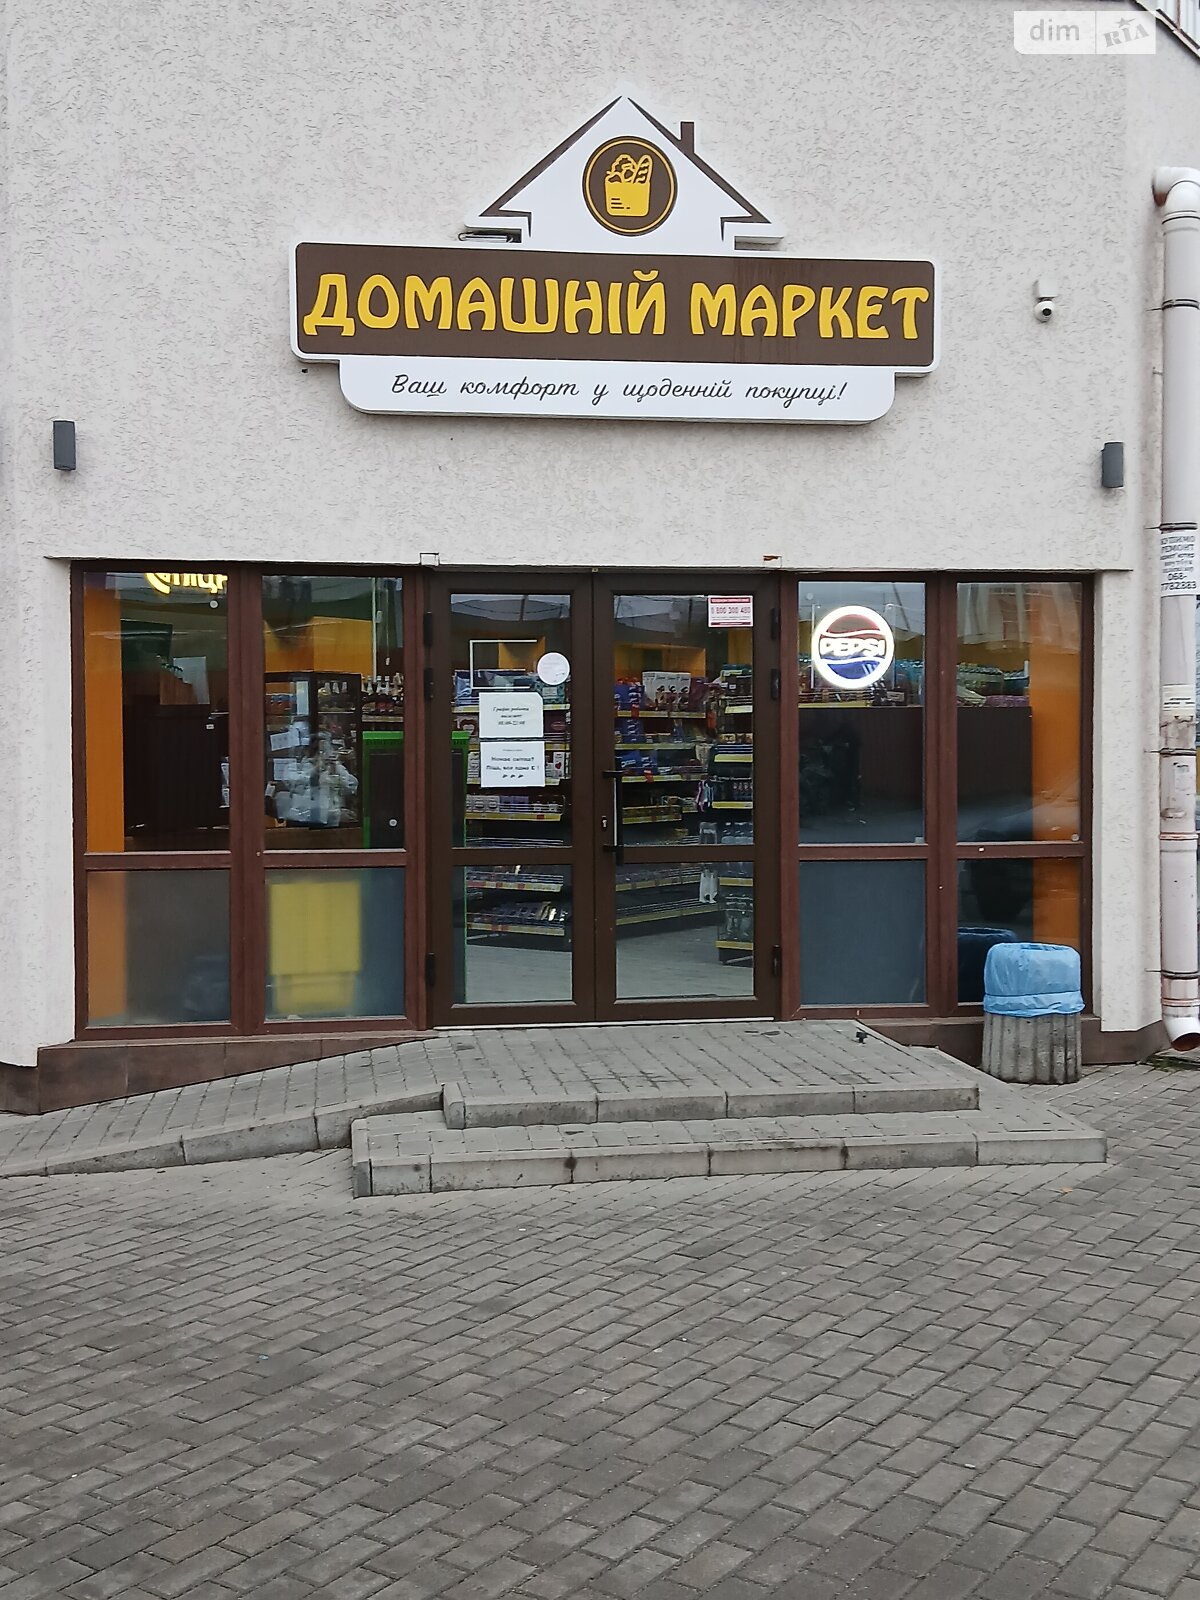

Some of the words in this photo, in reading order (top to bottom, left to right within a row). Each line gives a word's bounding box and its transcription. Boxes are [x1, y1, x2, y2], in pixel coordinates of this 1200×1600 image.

[303, 269, 666, 336] ДОМАШНІЙ
[690, 282, 929, 339] МАРКЕТ
[391, 374, 447, 398] Ваш
[460, 376, 579, 400] комфорт
[594, 383, 609, 406] у
[622, 378, 732, 402] щоденній
[744, 382, 848, 408] покупці!
[819, 637, 886, 657] PEPSI
